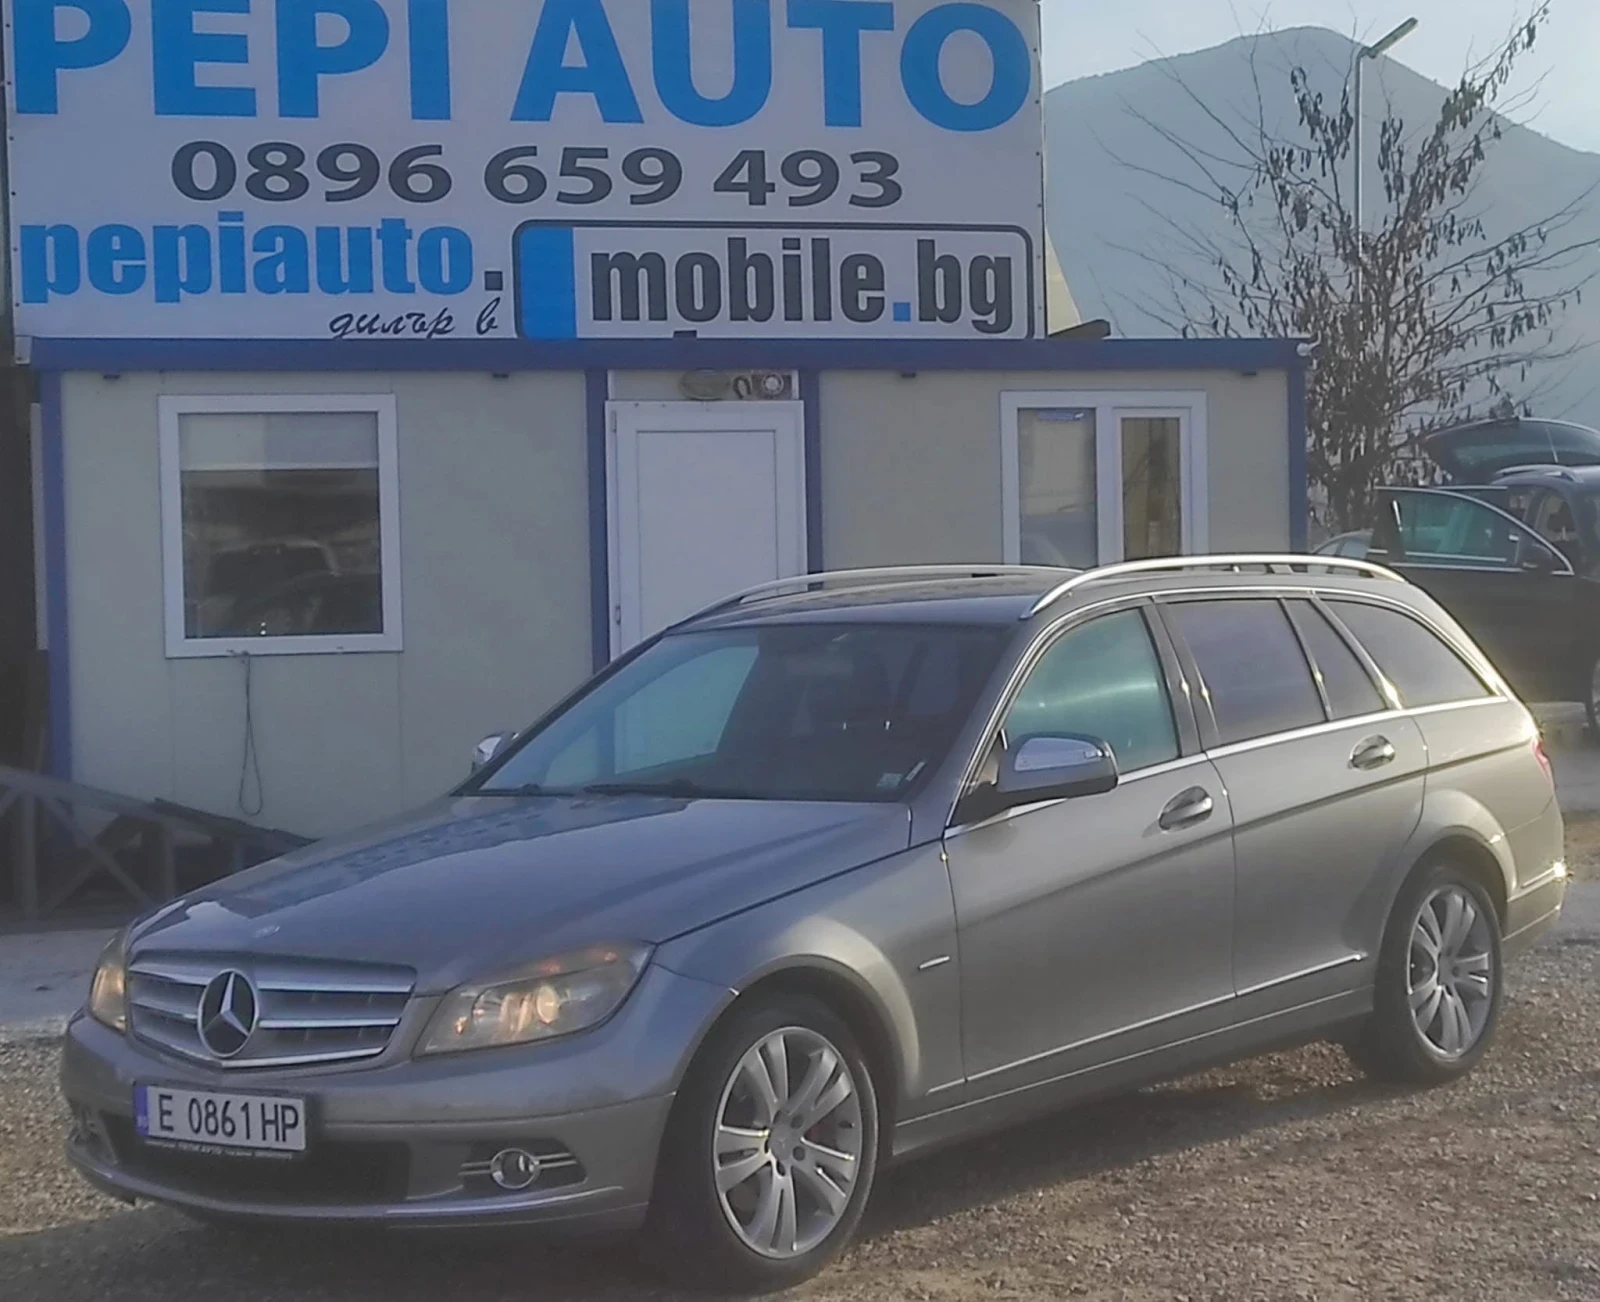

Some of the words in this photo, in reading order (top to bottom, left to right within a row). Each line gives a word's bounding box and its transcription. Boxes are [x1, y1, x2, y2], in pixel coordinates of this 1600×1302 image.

[13, 0, 452, 121] PEPI
[511, 0, 1030, 132] AUTO
[172, 141, 452, 203] 0896
[484, 147, 683, 205] 659
[713, 150, 902, 208] 493
[591, 237, 1013, 334] mobile.bg
[188, 1098, 252, 1140] 0861
[261, 1103, 299, 1142] HP
